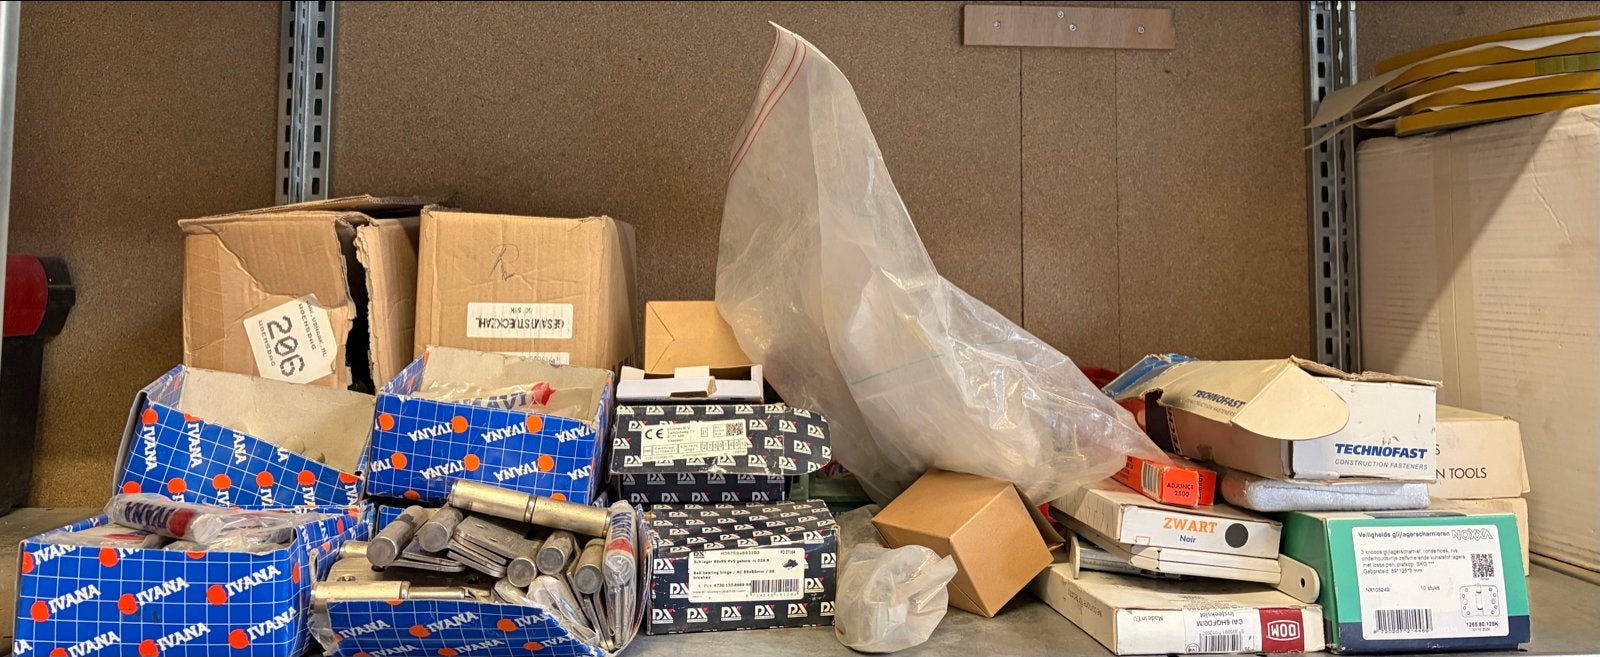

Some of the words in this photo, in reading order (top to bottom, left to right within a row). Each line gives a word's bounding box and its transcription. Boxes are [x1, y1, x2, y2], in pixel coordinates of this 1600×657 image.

[298, 303, 316, 350] WOENSDAG
[258, 320, 276, 367] WOENSDAG
[266, 315, 305, 377] 206
[1193, 390, 1246, 408] TECHNOFAST
[407, 422, 453, 442] IVANA
[481, 421, 526, 443] IVANA
[749, 419, 768, 430] DX
[779, 420, 797, 433] DX
[808, 424, 824, 439] DX
[143, 426, 157, 472] IVANA
[188, 423, 203, 468] IVANA
[764, 437, 783, 449] DX
[794, 440, 812, 454] DX
[1335, 444, 1428, 458] TECHNOFAST
[748, 455, 767, 467] DX
[779, 456, 796, 470] DX
[1335, 459, 1388, 468] CONSTRUCTION
[420, 460, 465, 480] IVANA
[493, 461, 539, 482] IVANA
[1449, 467, 1487, 479] TOOLS
[1163, 517, 1217, 533] ZWART
[804, 530, 824, 544] DX
[654, 558, 674, 573] DX
[225, 565, 281, 597] IVANA
[804, 578, 824, 593] DX
[48, 584, 101, 614] IVANA
[136, 577, 190, 606] IVANA
[653, 609, 674, 624] DX
[687, 608, 708, 622] DX
[721, 606, 742, 621] DX
[755, 604, 774, 619] DX
[788, 603, 808, 618] DX
[247, 606, 297, 641] IVANA
[426, 611, 478, 632] IVANA
[156, 622, 211, 651] IVANA
[339, 620, 391, 639] IVANA
[1271, 624, 1296, 637] DOM
[68, 630, 120, 657] IVANA
